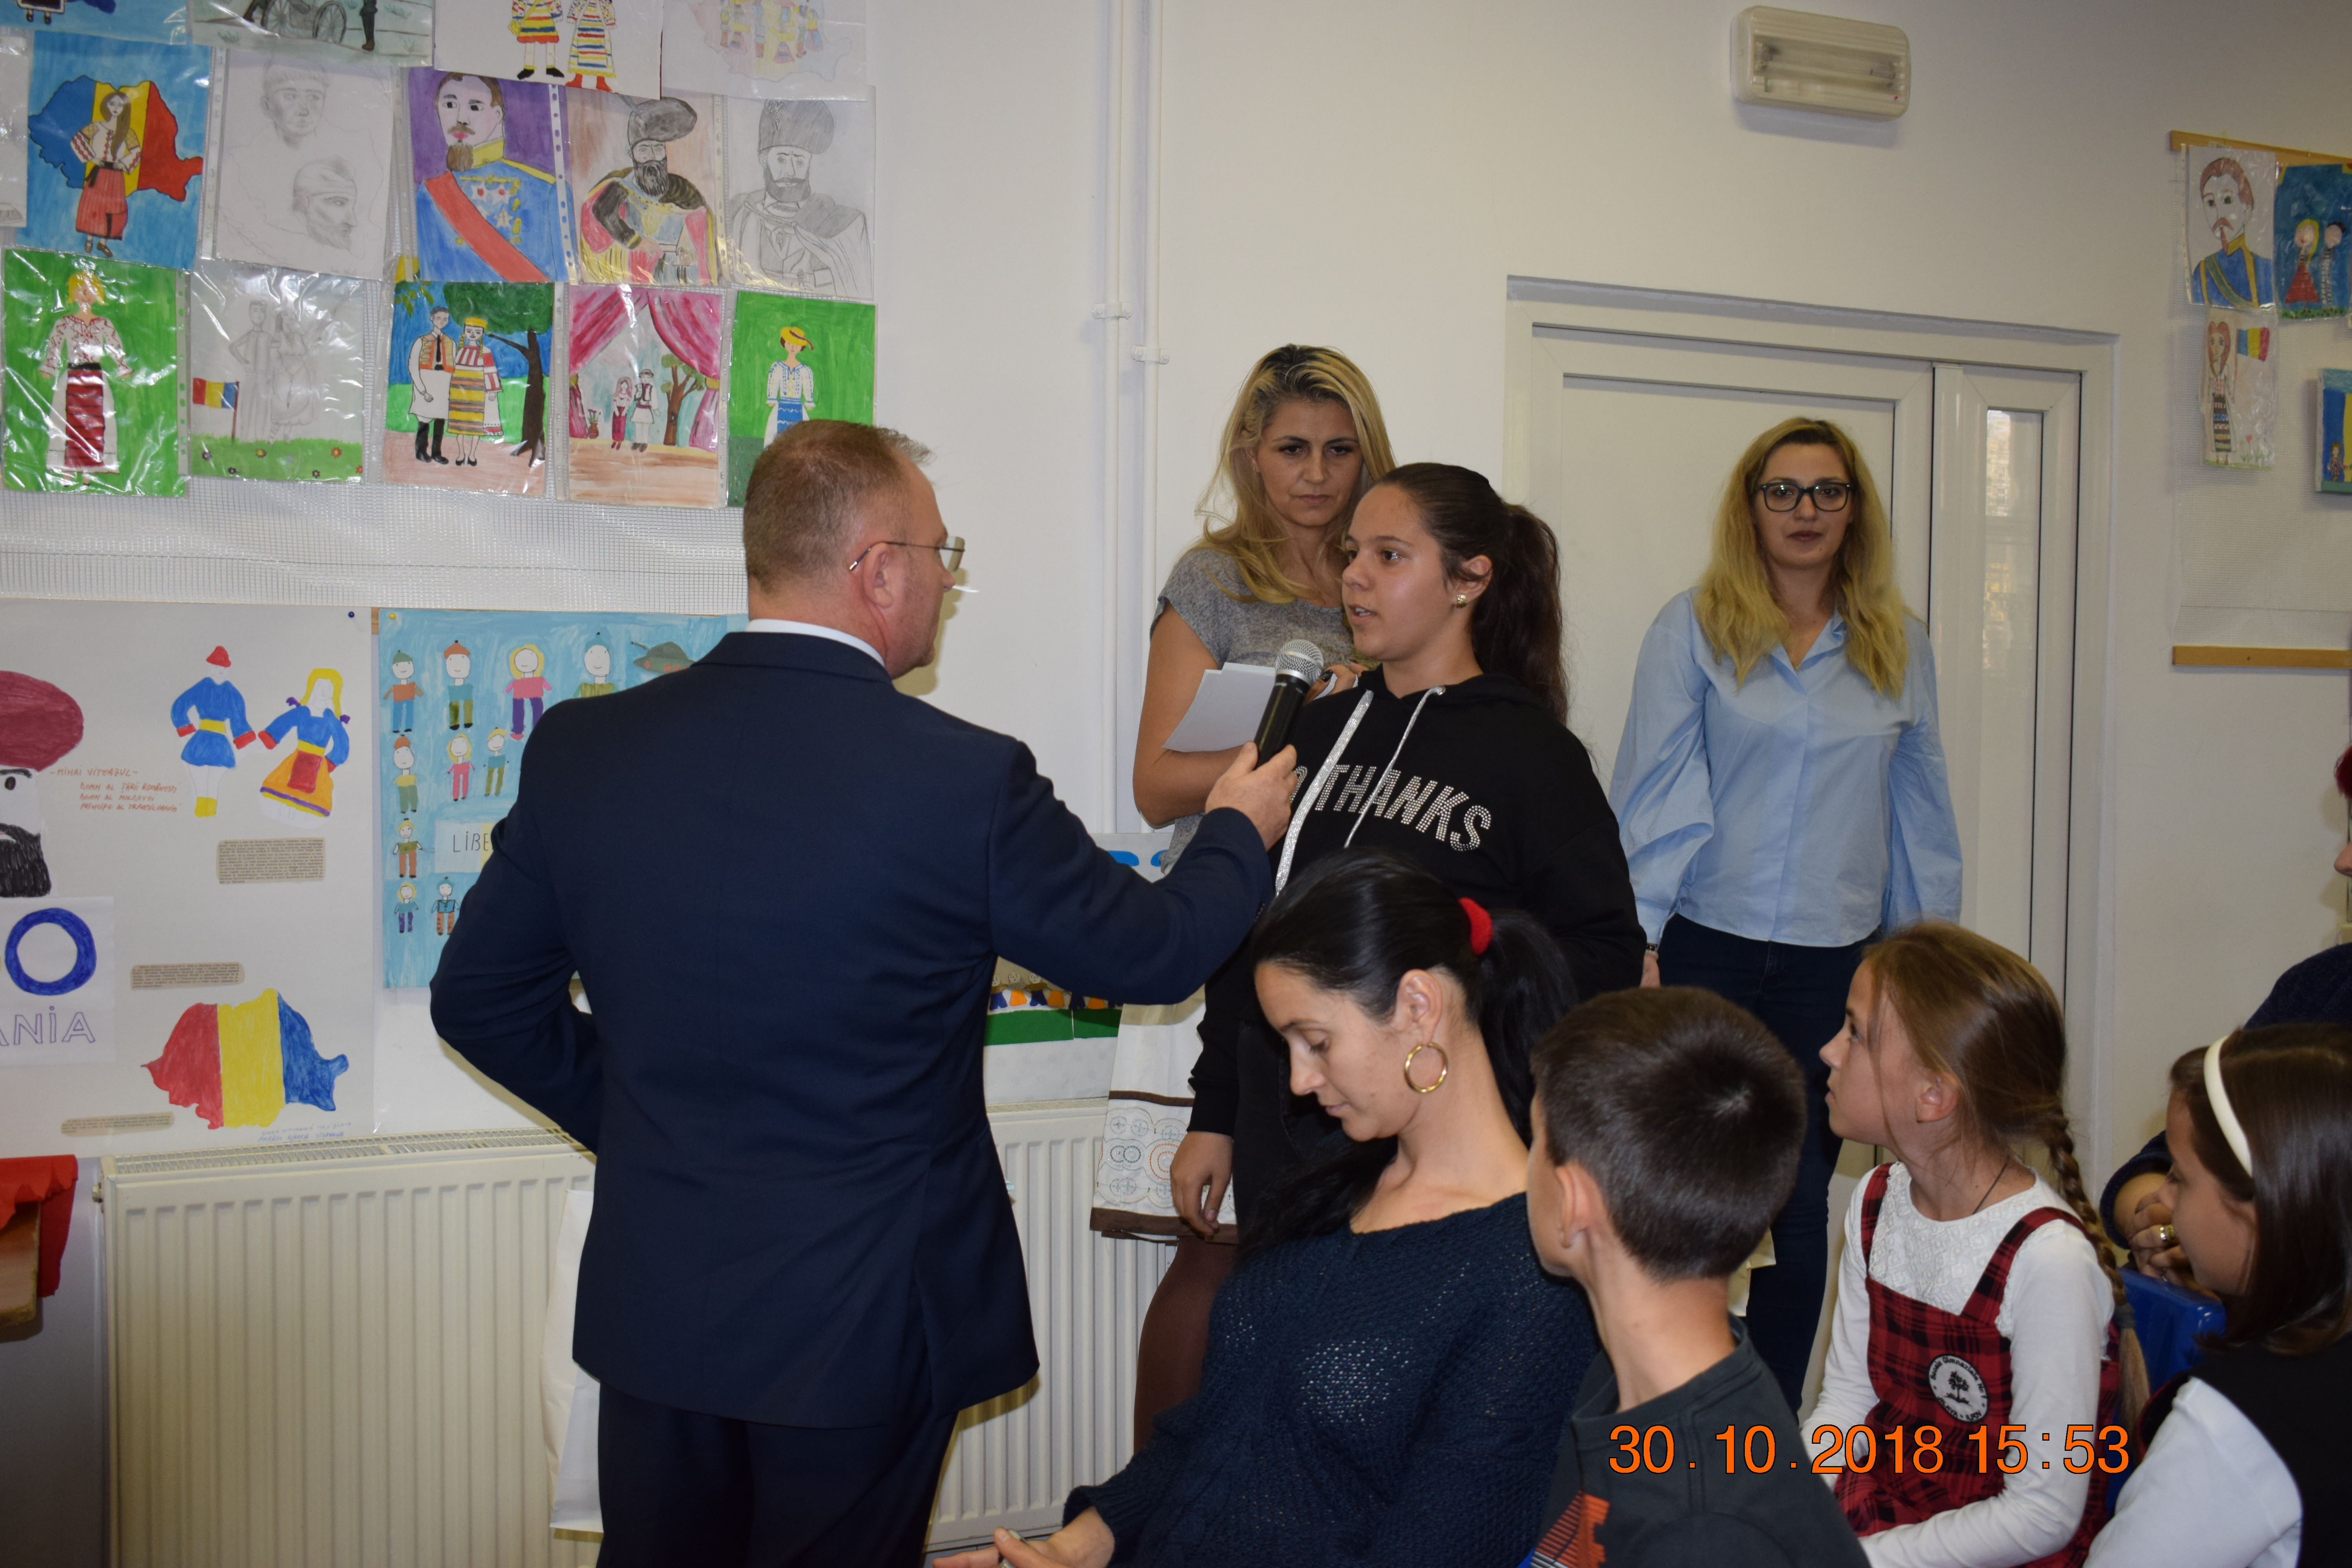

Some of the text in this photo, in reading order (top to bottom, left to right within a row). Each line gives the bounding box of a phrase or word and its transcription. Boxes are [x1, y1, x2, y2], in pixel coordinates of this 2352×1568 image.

[1315, 764, 1491, 851] THANKS
[453, 831, 490, 852] LIBE
[0, 1005, 96, 1046] NIA
